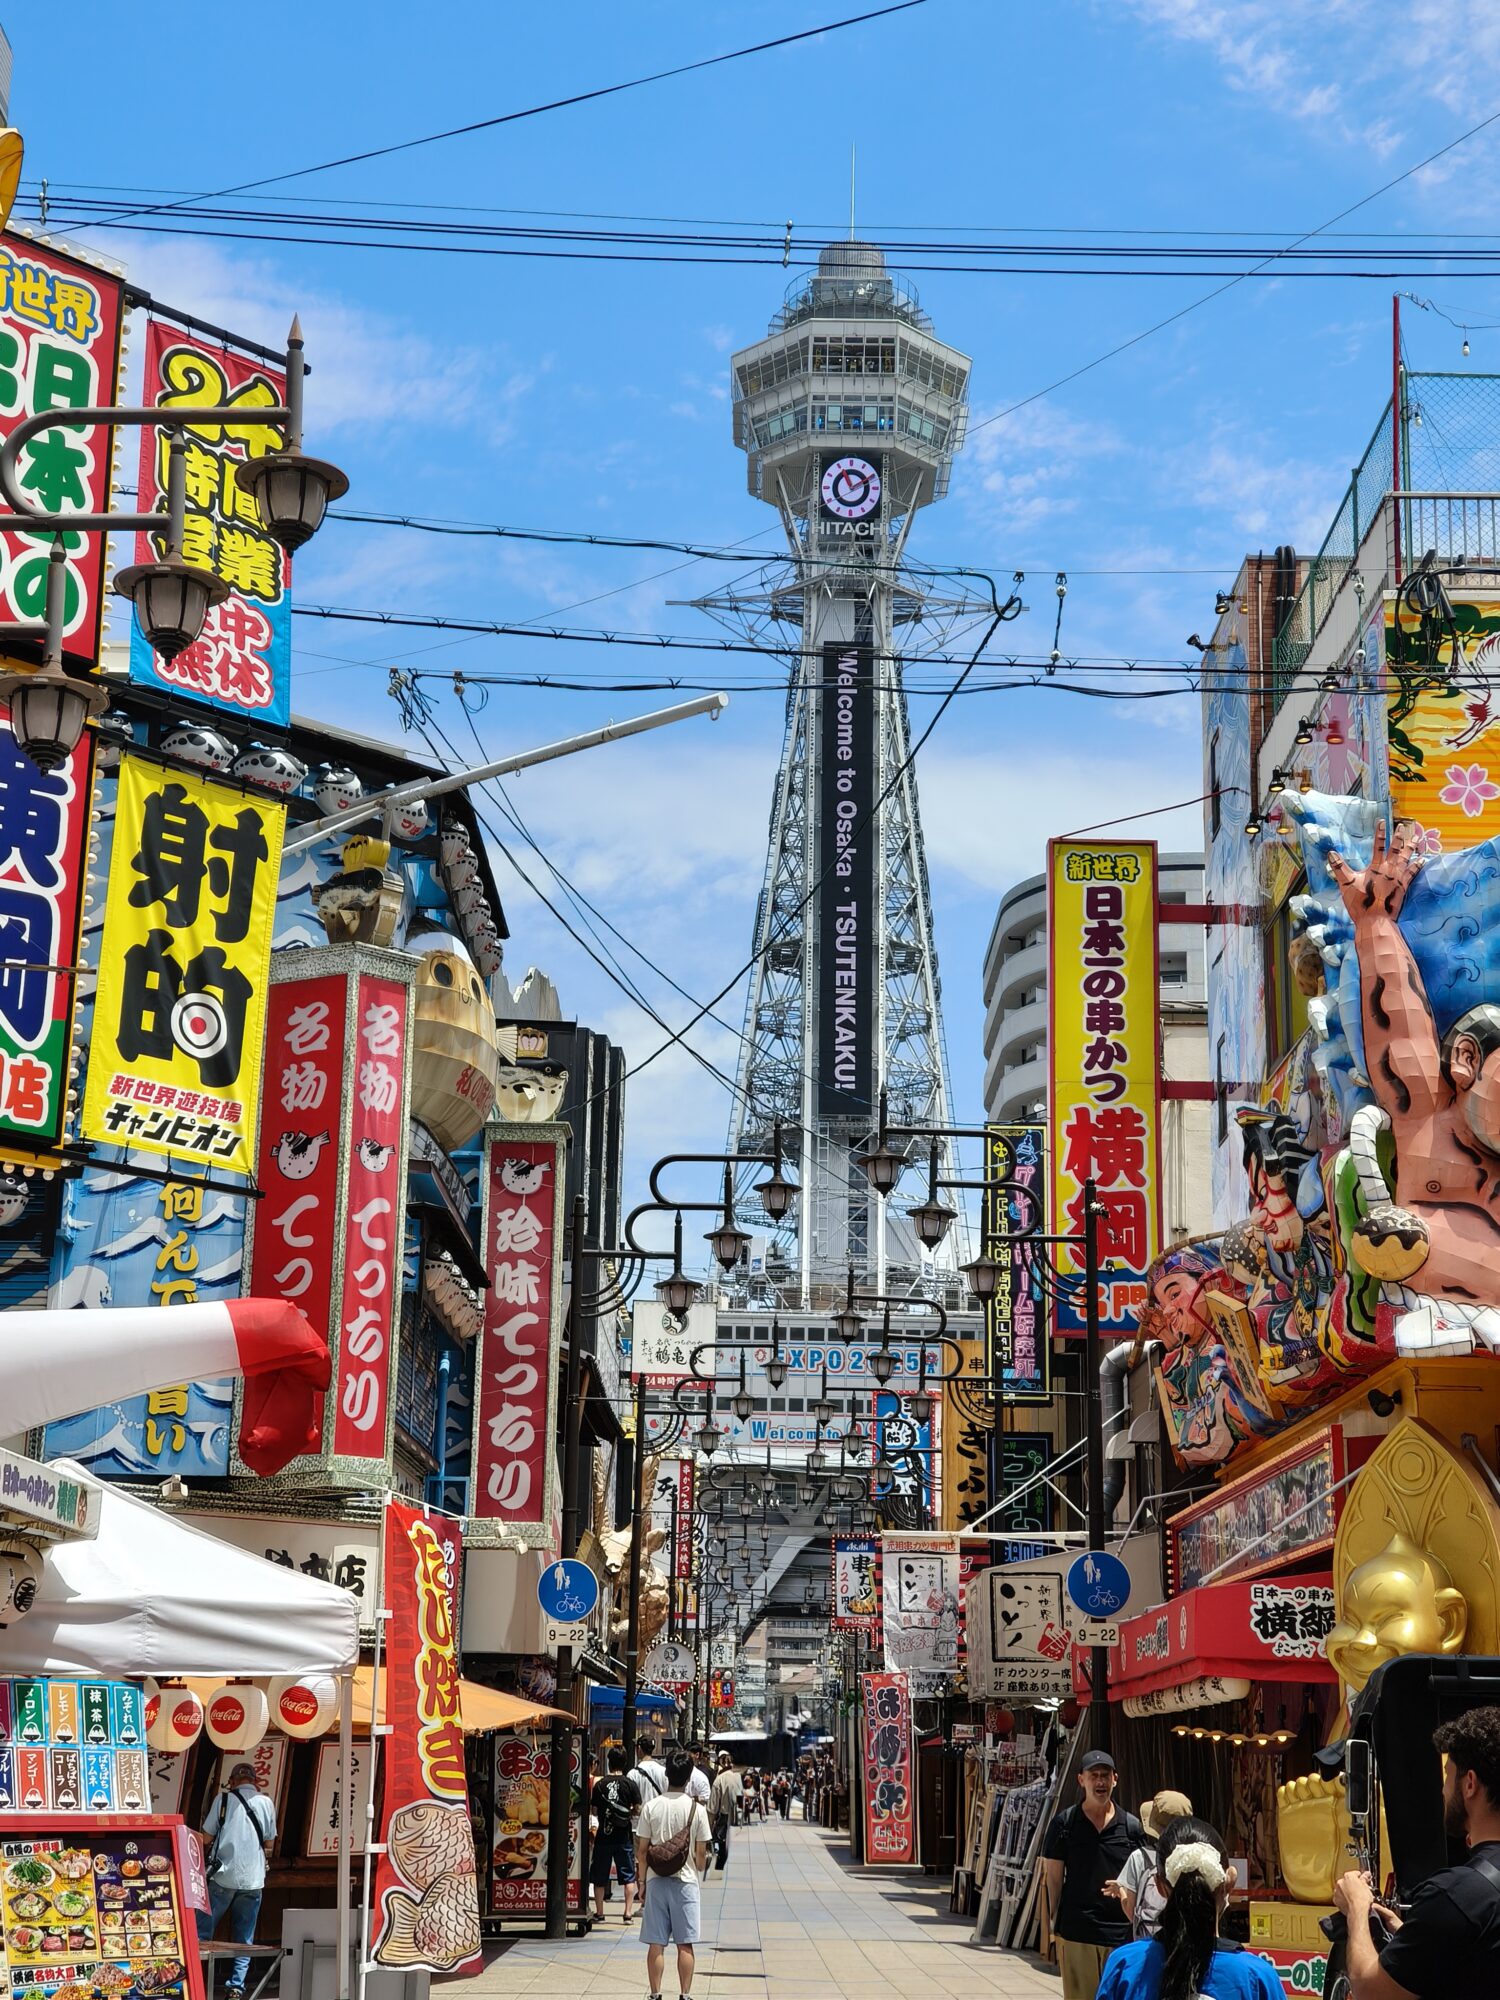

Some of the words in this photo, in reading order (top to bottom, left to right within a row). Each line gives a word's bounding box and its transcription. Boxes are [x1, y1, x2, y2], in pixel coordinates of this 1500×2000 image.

[812, 521, 889, 537] HITACHI
[836, 651, 858, 761] Welcome
[837, 768, 857, 793] to
[836, 801, 858, 877] Osaka
[1067, 855, 1139, 881] 新世界
[117, 783, 268, 1087] 射的
[834, 901, 857, 1090] TSUTENKAKU!
[1083, 886, 1126, 1102] 日本一の串かつ
[281, 1001, 330, 1113] 名物
[359, 1002, 400, 1115] 名物
[109, 1076, 242, 1122] 新世界遊技場
[106, 1103, 241, 1157] チャンピオン
[1066, 1106, 1147, 1272] 横綱
[342, 1197, 391, 1431] てっちり
[488, 1205, 543, 1510] 珍味てっちり
[846, 1542, 869, 1551] Asahi
[851, 1554, 873, 1601] 串カツ
[994, 1667, 1004, 1678] 1F
[994, 1681, 1004, 1692] 2F
[1007, 1681, 1072, 1693] 座敷あります
[25, 1688, 36, 1720] メロン
[58, 1689, 69, 1722] レモン
[89, 1690, 103, 1722] 抹茶
[210, 1708, 242, 1721] Coca-Cola
[280, 1697, 317, 1715] Coca-Cola
[26, 1753, 38, 1785] マンゴー
[55, 1755, 65, 1786] コーラ
[87, 1755, 98, 1786] ラムネ
